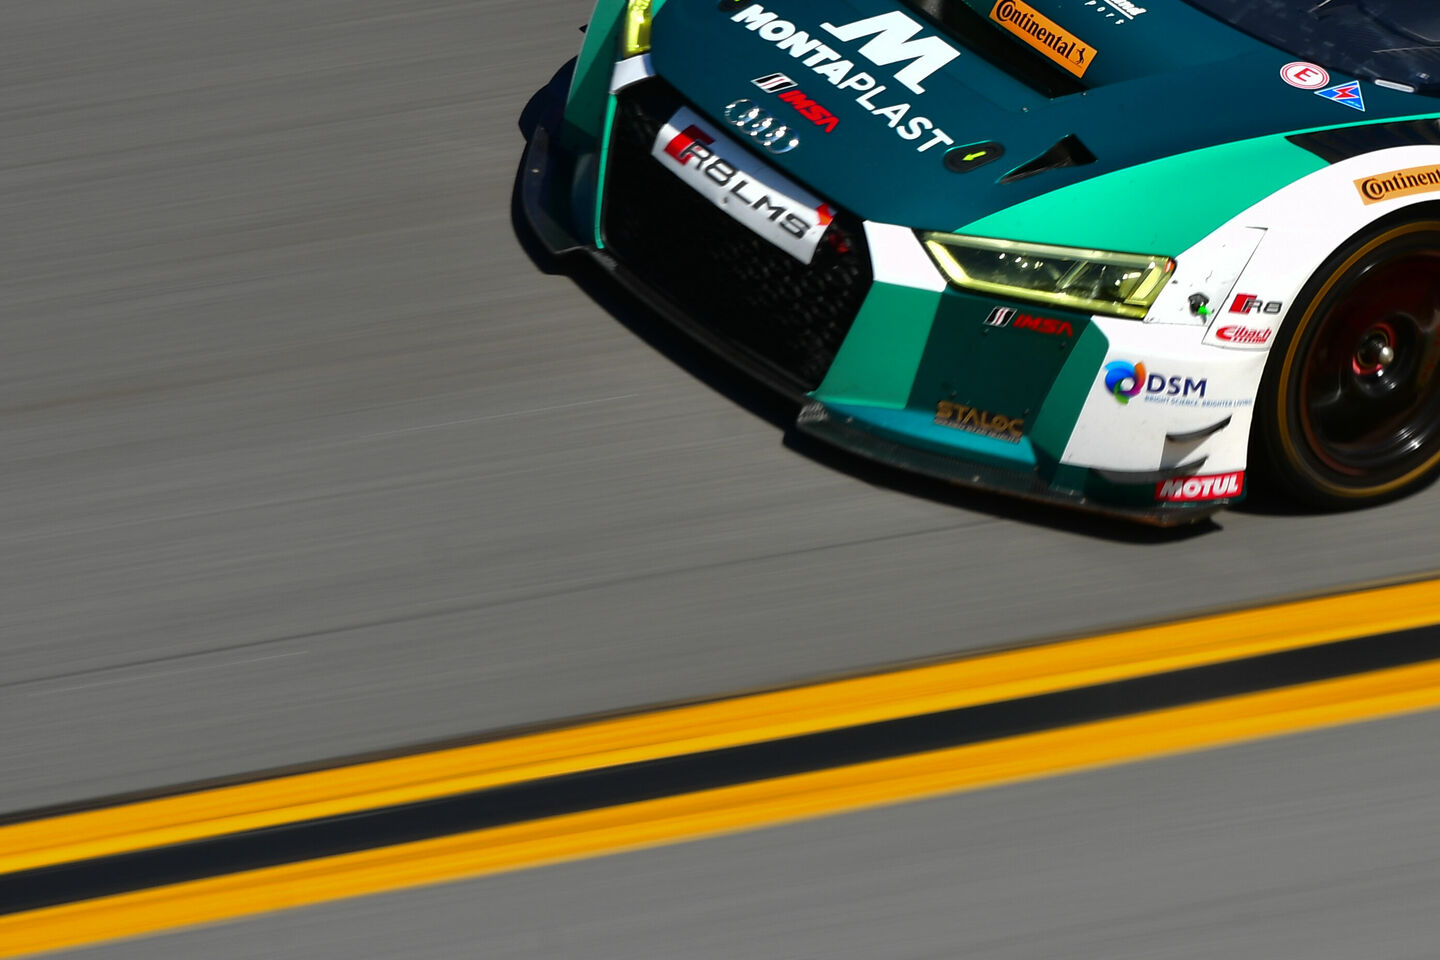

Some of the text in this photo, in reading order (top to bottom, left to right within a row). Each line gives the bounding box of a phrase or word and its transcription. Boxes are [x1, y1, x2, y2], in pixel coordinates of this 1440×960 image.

[819, 10, 961, 95] M
[730, 3, 954, 153] MONTAPLAST
[1294, 68, 1318, 82] E
[778, 90, 840, 134] IMSA
[1241, 297, 1283, 315] R8
[1013, 313, 1073, 337] IMSA
[1146, 372, 1207, 398] DSM
[936, 400, 1024, 438] STALOC
[1160, 473, 1238, 498] MOTUL
